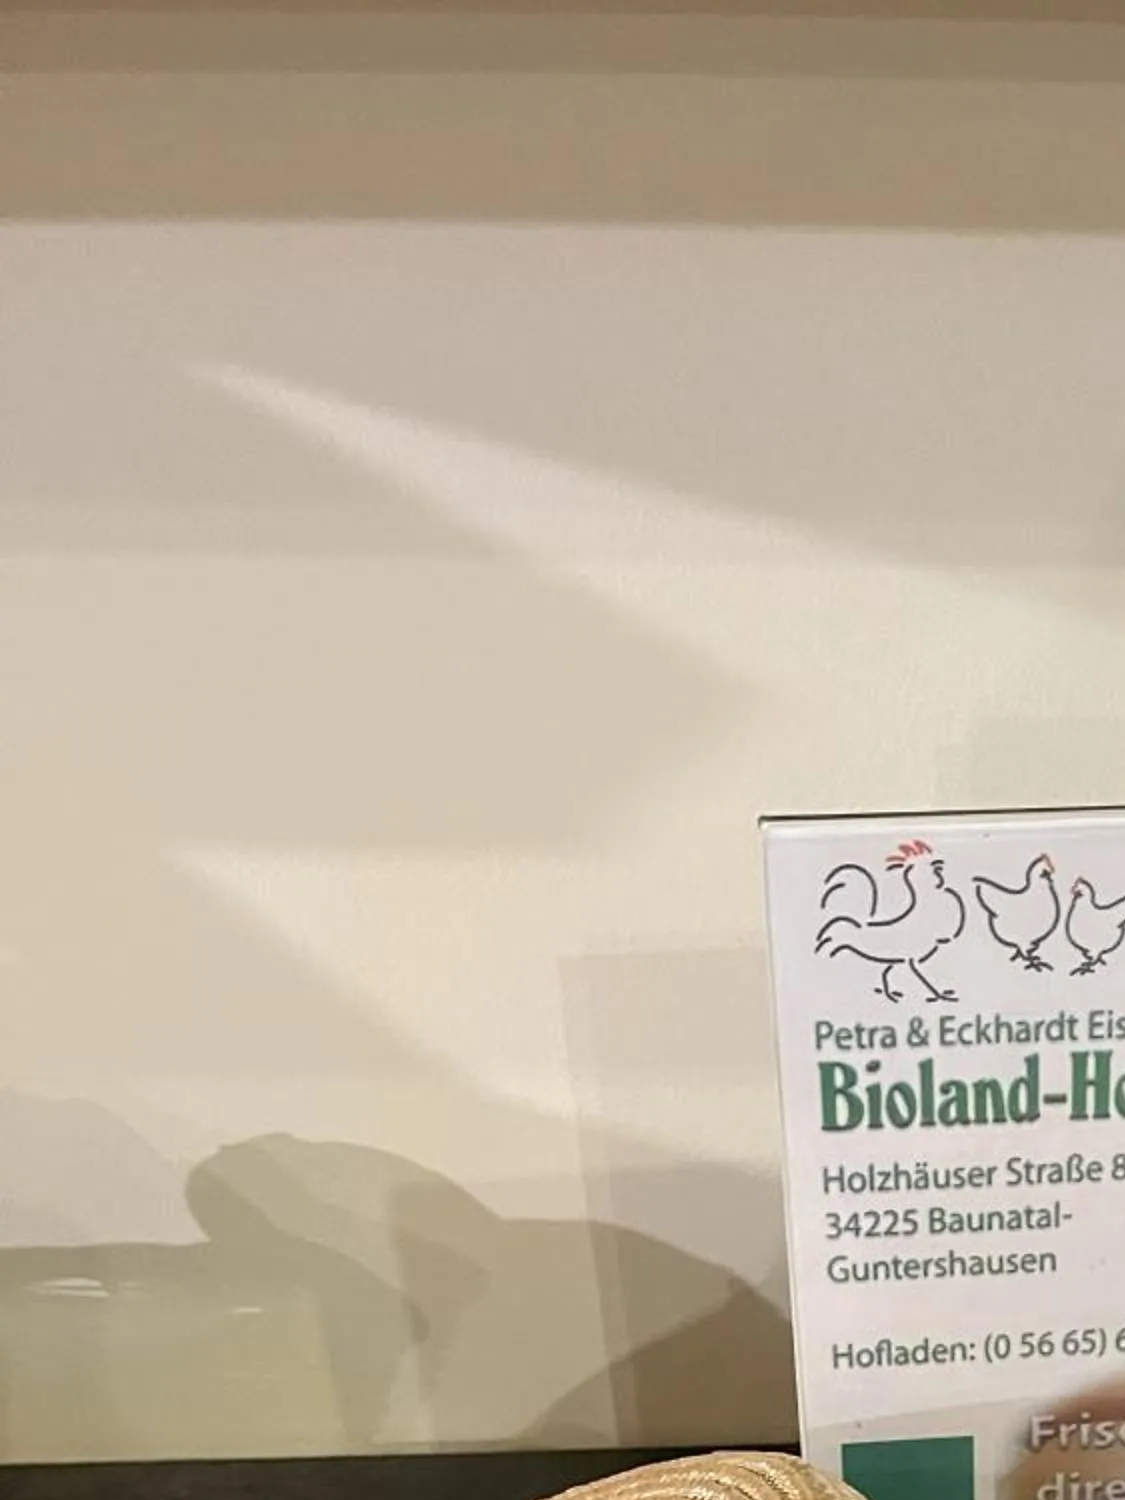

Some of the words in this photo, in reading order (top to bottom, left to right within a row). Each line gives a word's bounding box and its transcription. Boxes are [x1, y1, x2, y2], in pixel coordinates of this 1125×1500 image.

[814, 1019, 898, 1051] Petra
[907, 1016, 929, 1046] &
[938, 1011, 1078, 1046] Eckhardt
[822, 1162, 997, 1194] Holzhäuser
[1005, 1154, 1103, 1187] Straße
[825, 1208, 918, 1239] 34225
[928, 1201, 1073, 1233] Baunatal-
[827, 1249, 1057, 1282] Guntershausen
[832, 1338, 976, 1369] Hofladen:
[984, 1333, 1012, 1362] (0
[1020, 1329, 1055, 1357] 56
[1061, 1328, 1107, 1357] 65)
